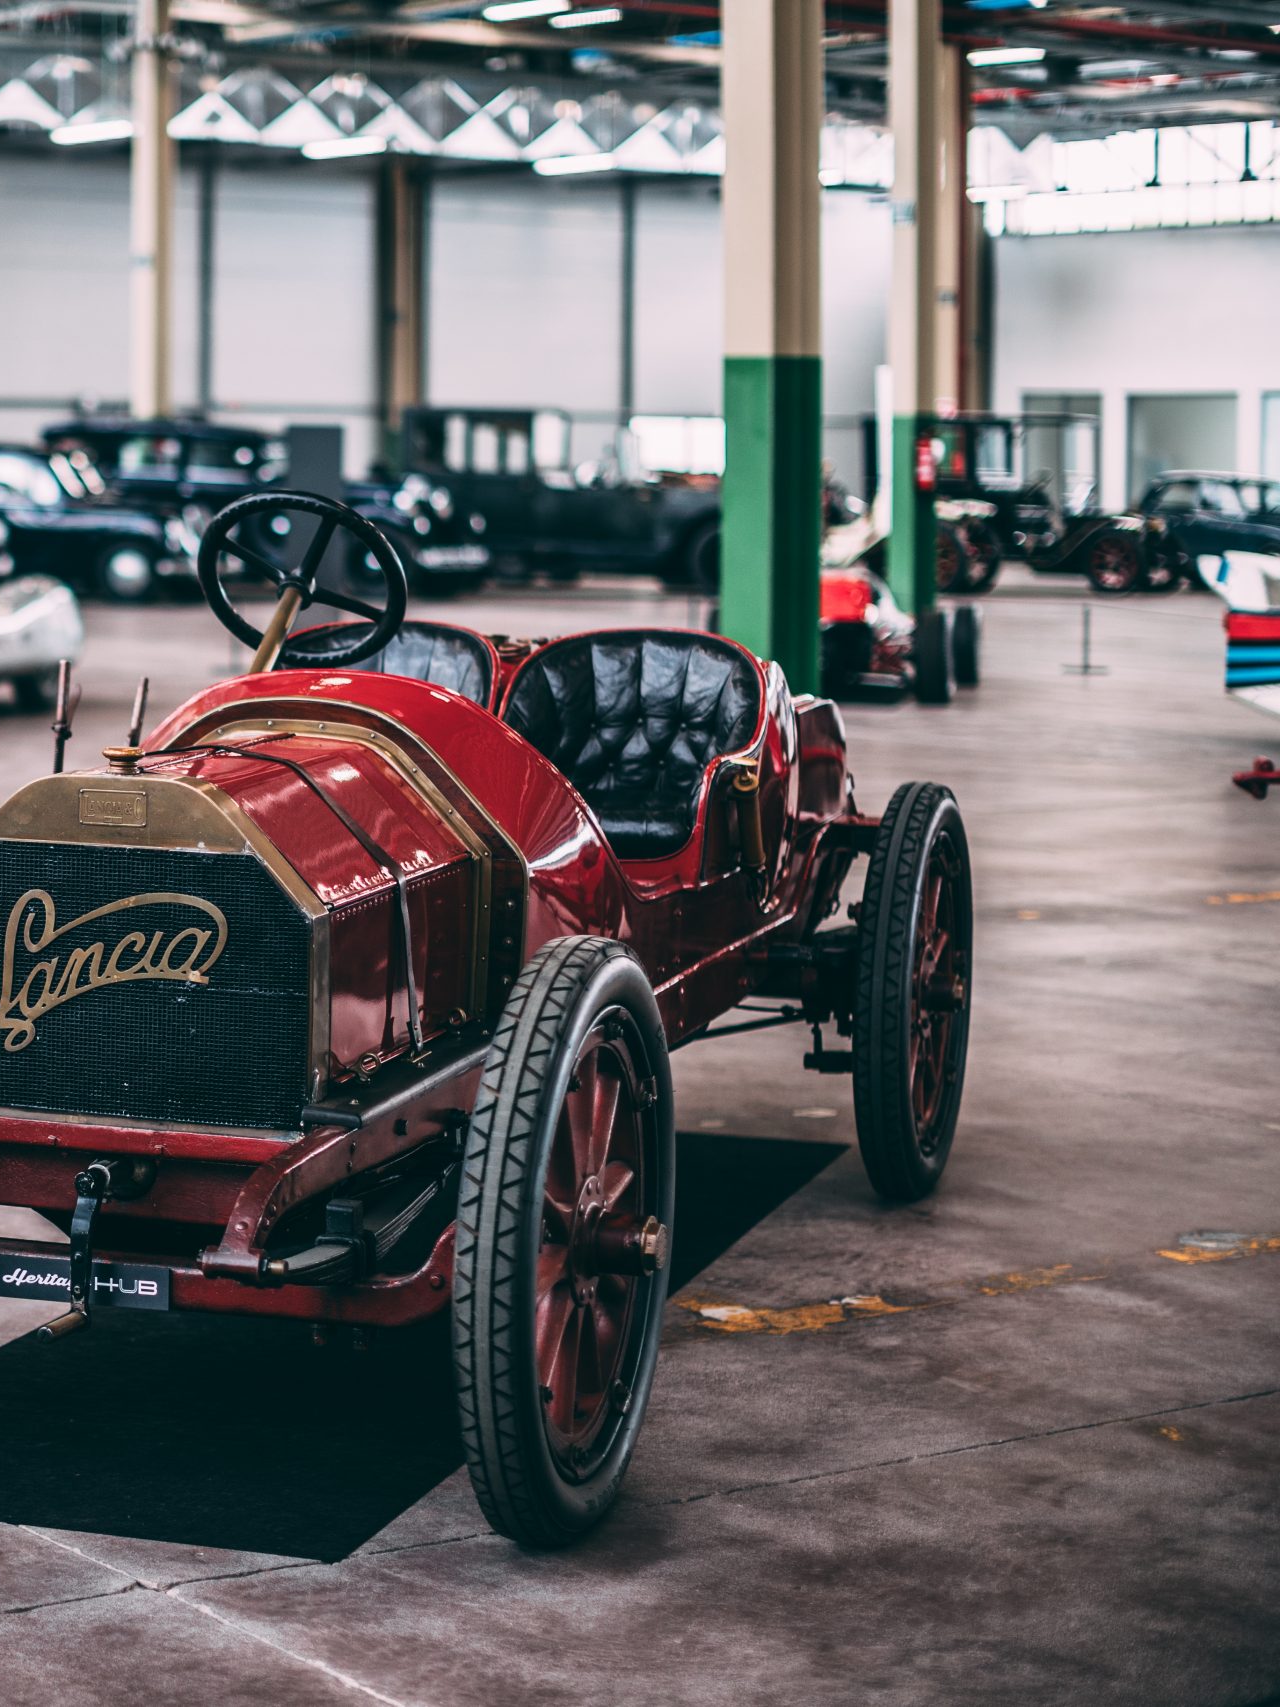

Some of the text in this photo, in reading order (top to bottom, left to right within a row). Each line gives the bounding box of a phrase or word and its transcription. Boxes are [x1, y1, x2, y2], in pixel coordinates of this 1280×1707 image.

[125, 801, 133, 816] &
[2, 1267, 158, 1296] Herita HUB
